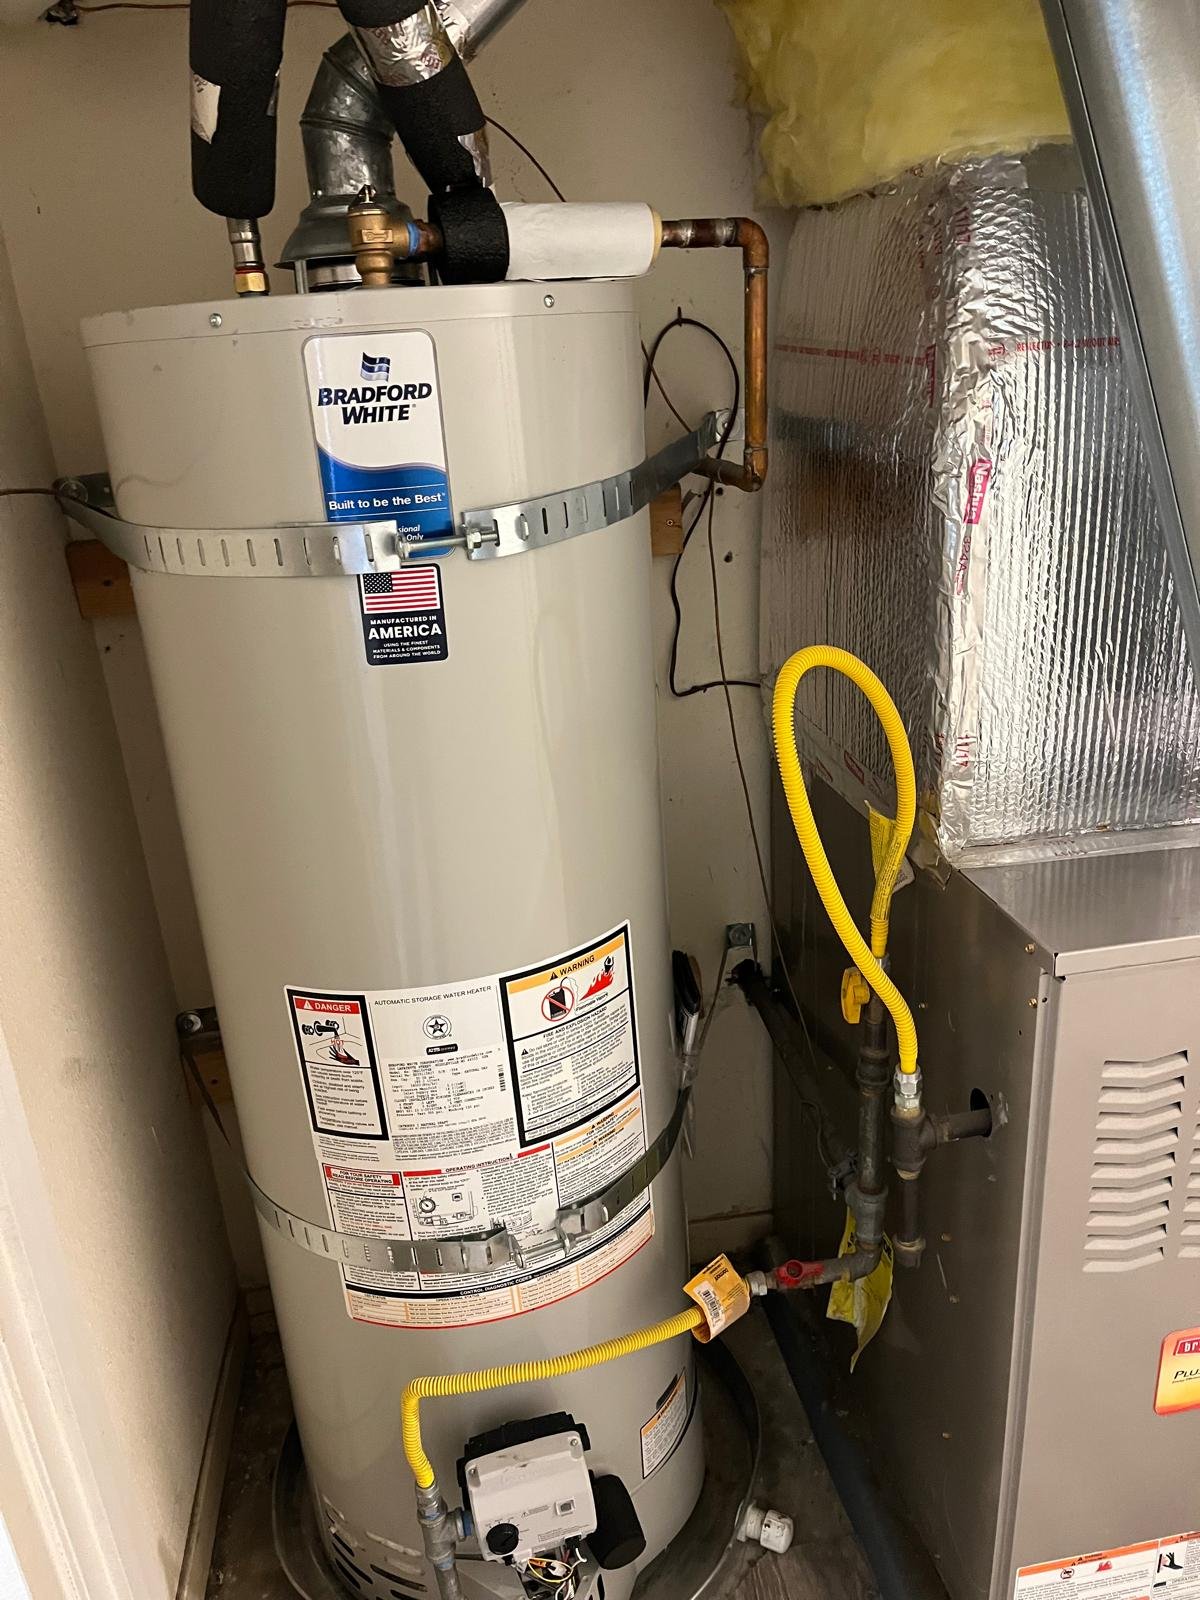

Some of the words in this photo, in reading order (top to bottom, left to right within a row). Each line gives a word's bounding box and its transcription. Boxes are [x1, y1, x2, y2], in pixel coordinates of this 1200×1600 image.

[317, 383, 432, 406] BRADFORD
[342, 404, 410, 424] WHITE
[329, 501, 354, 510] Built
[357, 500, 369, 508] to
[373, 497, 388, 507] be
[392, 496, 411, 505] the
[415, 493, 442, 503] Best
[370, 616, 427, 625] MANUFACTURED
[368, 624, 442, 640] AMERICA
[560, 955, 595, 976] WARNING
[412, 995, 442, 1004] STORAGE
[443, 991, 466, 999] WATER
[466, 986, 492, 996] HEATER
[314, 1003, 351, 1012] DANGER
[566, 1016, 590, 1030] EXPLOSION
[591, 1007, 607, 1017] HAZARD
[445, 1164, 476, 1173] OPERATING
[484, 1280, 514, 1292] DIAGNOSTIC
[516, 1274, 533, 1284] CODES
[1184, 1341, 1200, 1352] br
